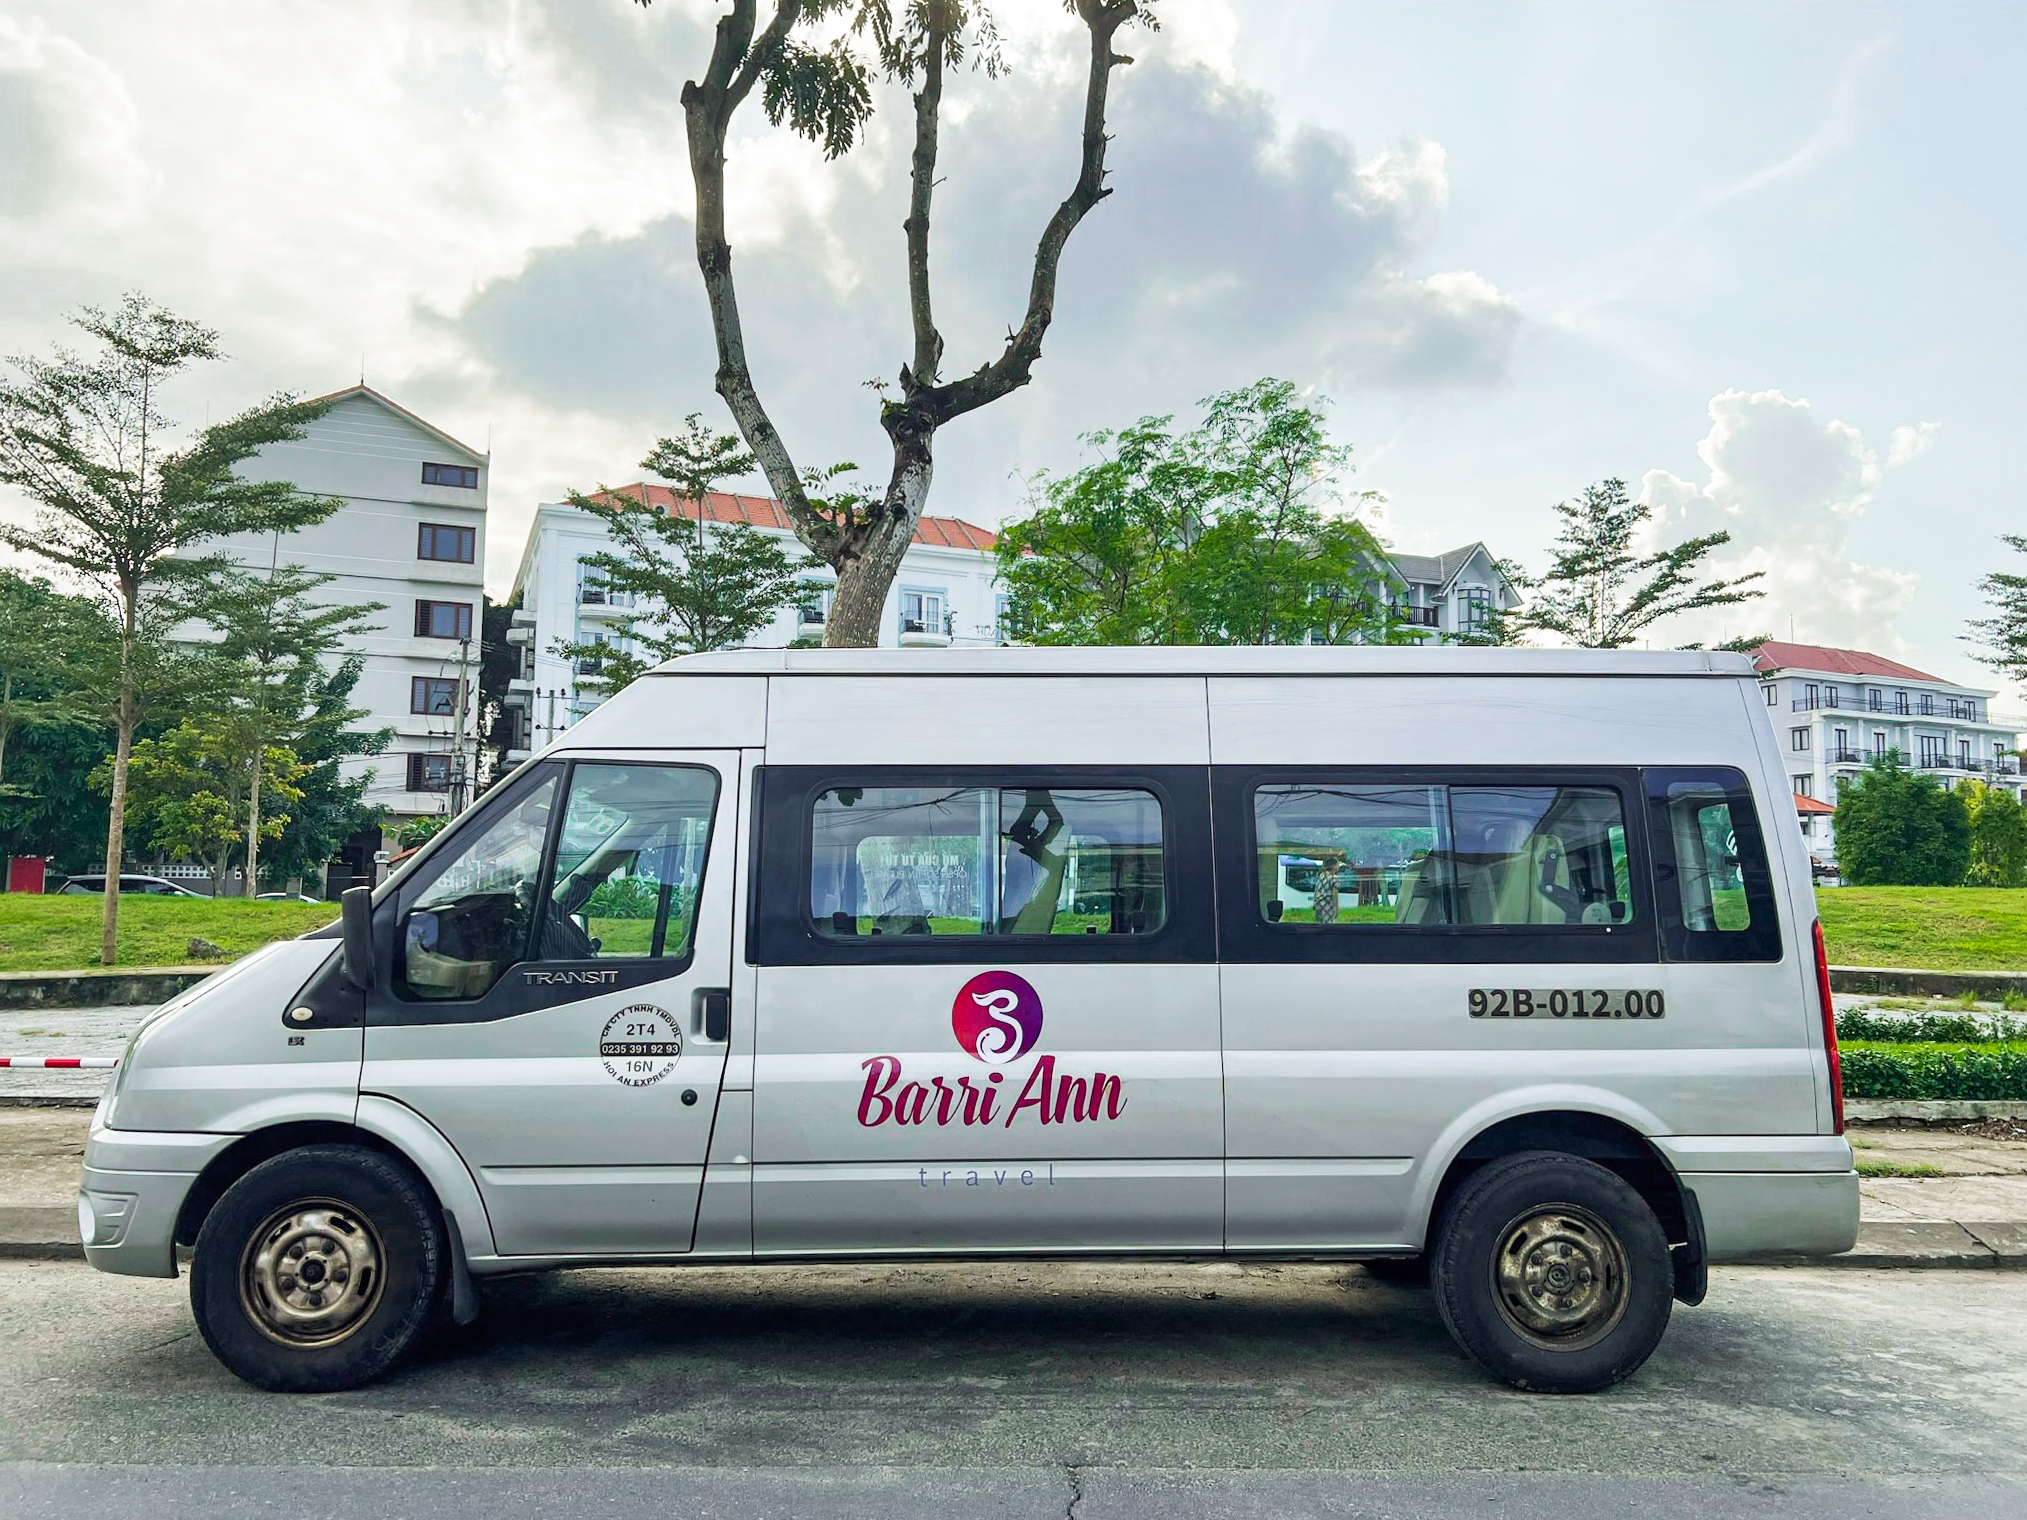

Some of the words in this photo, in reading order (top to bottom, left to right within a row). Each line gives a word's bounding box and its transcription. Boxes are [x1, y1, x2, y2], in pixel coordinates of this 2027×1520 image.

[522, 970, 619, 985] TRANSIT
[1469, 989, 1665, 1018] 92B-012.00
[610, 1009, 626, 1025] CTY
[628, 1005, 654, 1014] TNHH
[626, 1023, 656, 1036] 2T4
[602, 1044, 627, 1054] 0235
[629, 1044, 648, 1054] 391
[650, 1044, 664, 1054] 92
[665, 1044, 679, 1054] 93
[617, 1075, 632, 1086] AN
[633, 1061, 674, 1086] EXPRESS
[626, 1060, 653, 1073] 16N
[857, 1055, 1004, 1127] Barri
[1004, 1054, 1128, 1128] Ann
[918, 1163, 1055, 1188] travel
